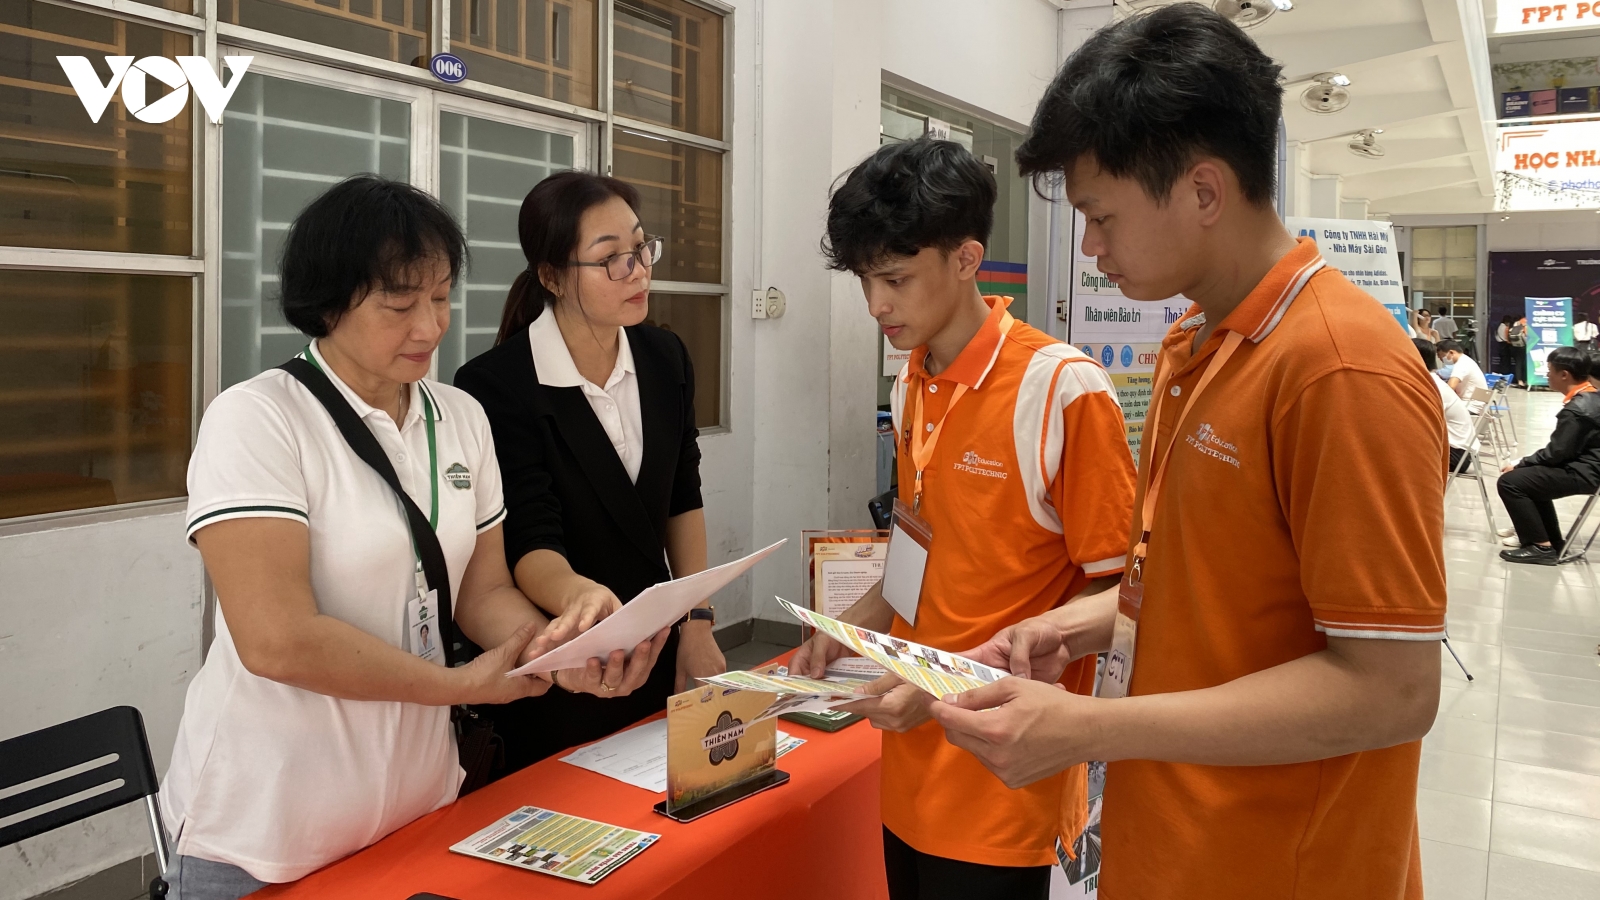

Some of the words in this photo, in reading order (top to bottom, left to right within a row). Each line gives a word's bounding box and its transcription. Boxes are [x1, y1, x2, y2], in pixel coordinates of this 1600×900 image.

[1522, 4, 1567, 24] FPT
[435, 58, 463, 78] 006
[1514, 152, 1559, 173] HỌC
[1324, 229, 1341, 240] Công
[1342, 231, 1349, 240] ty
[1350, 230, 1367, 240] TNHH
[1333, 243, 1347, 253] Nhà
[1348, 244, 1362, 254] Máy
[1364, 244, 1374, 253] Sài
[1082, 271, 1099, 292] Công
[1085, 306, 1102, 322] Nhân
[1103, 308, 1117, 322] viên
[1118, 307, 1131, 322] Bảo
[978, 457, 1003, 468] Education
[965, 465, 1008, 480] POLYTECHNIC
[704, 733, 727, 748] THIÊN
[728, 728, 744, 739] NAM
